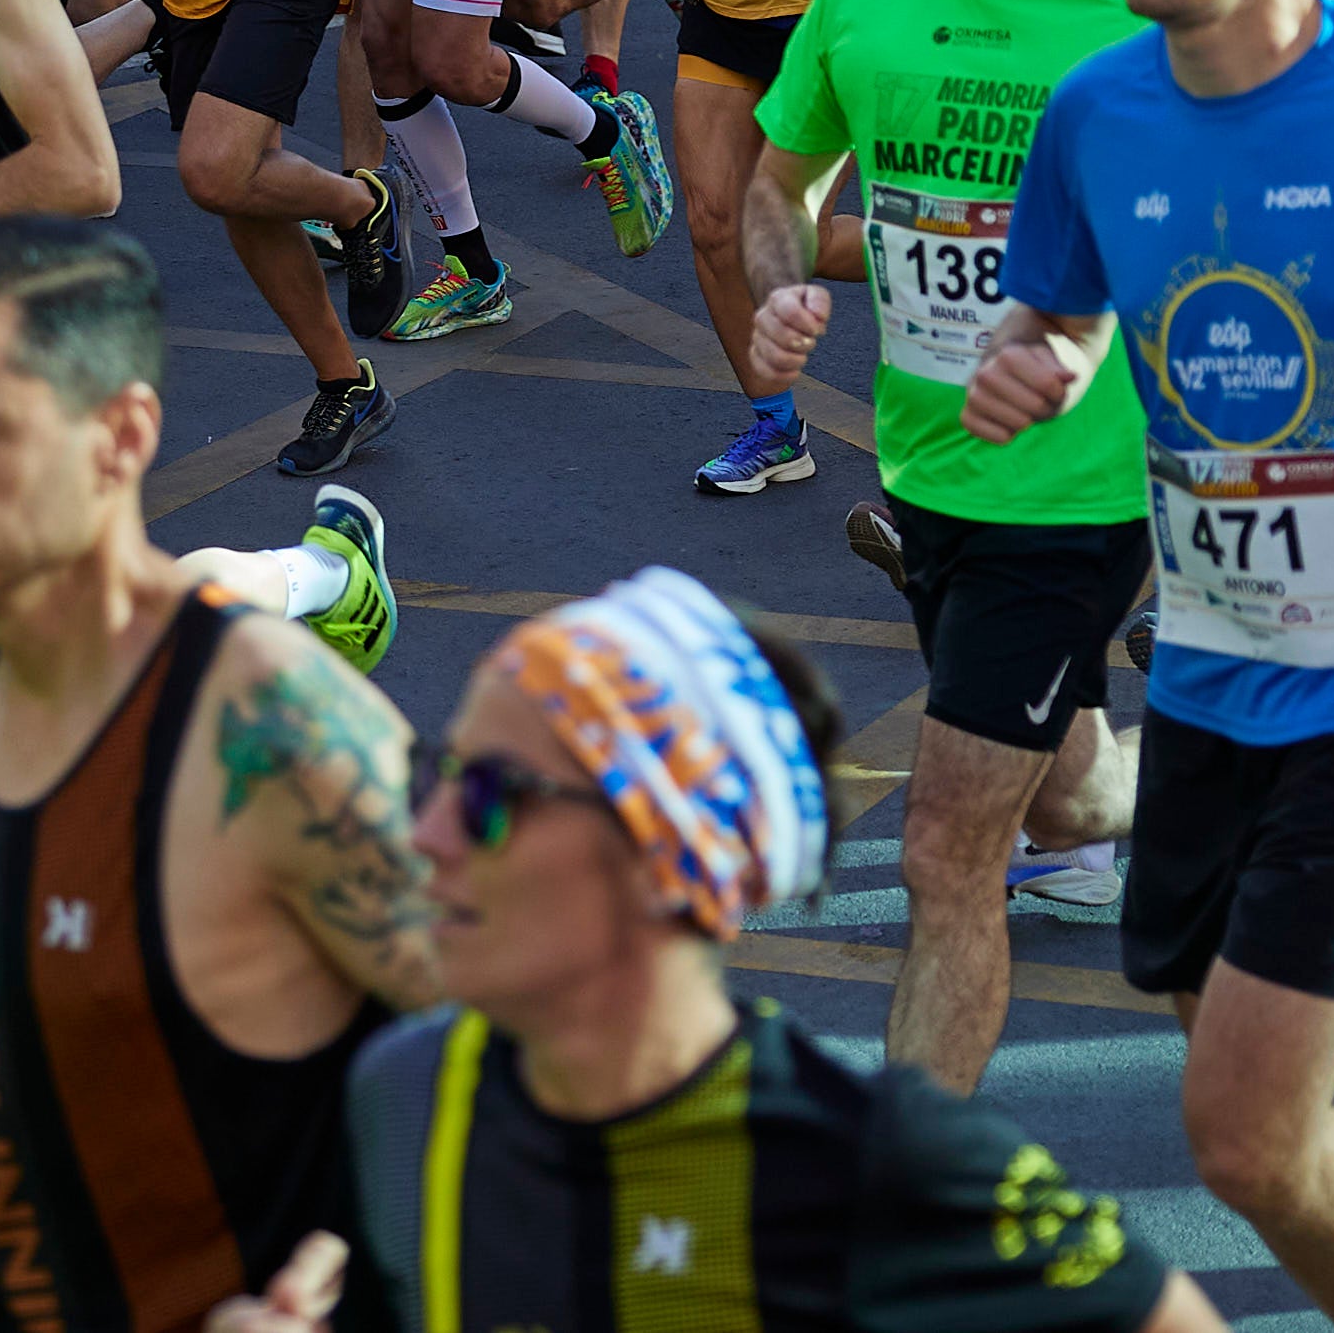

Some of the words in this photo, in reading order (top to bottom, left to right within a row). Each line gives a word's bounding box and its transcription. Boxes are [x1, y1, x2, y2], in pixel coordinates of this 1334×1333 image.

[954, 27, 1012, 42] OXIMESA
[937, 106, 1041, 150] PADR
[1264, 185, 1332, 211] HOKA
[906, 238, 1005, 305] 138
[929, 303, 979, 324] MANUEL
[1208, 316, 1252, 354] edp
[1191, 505, 1305, 573] 471
[1223, 576, 1286, 598] ANTONIO
